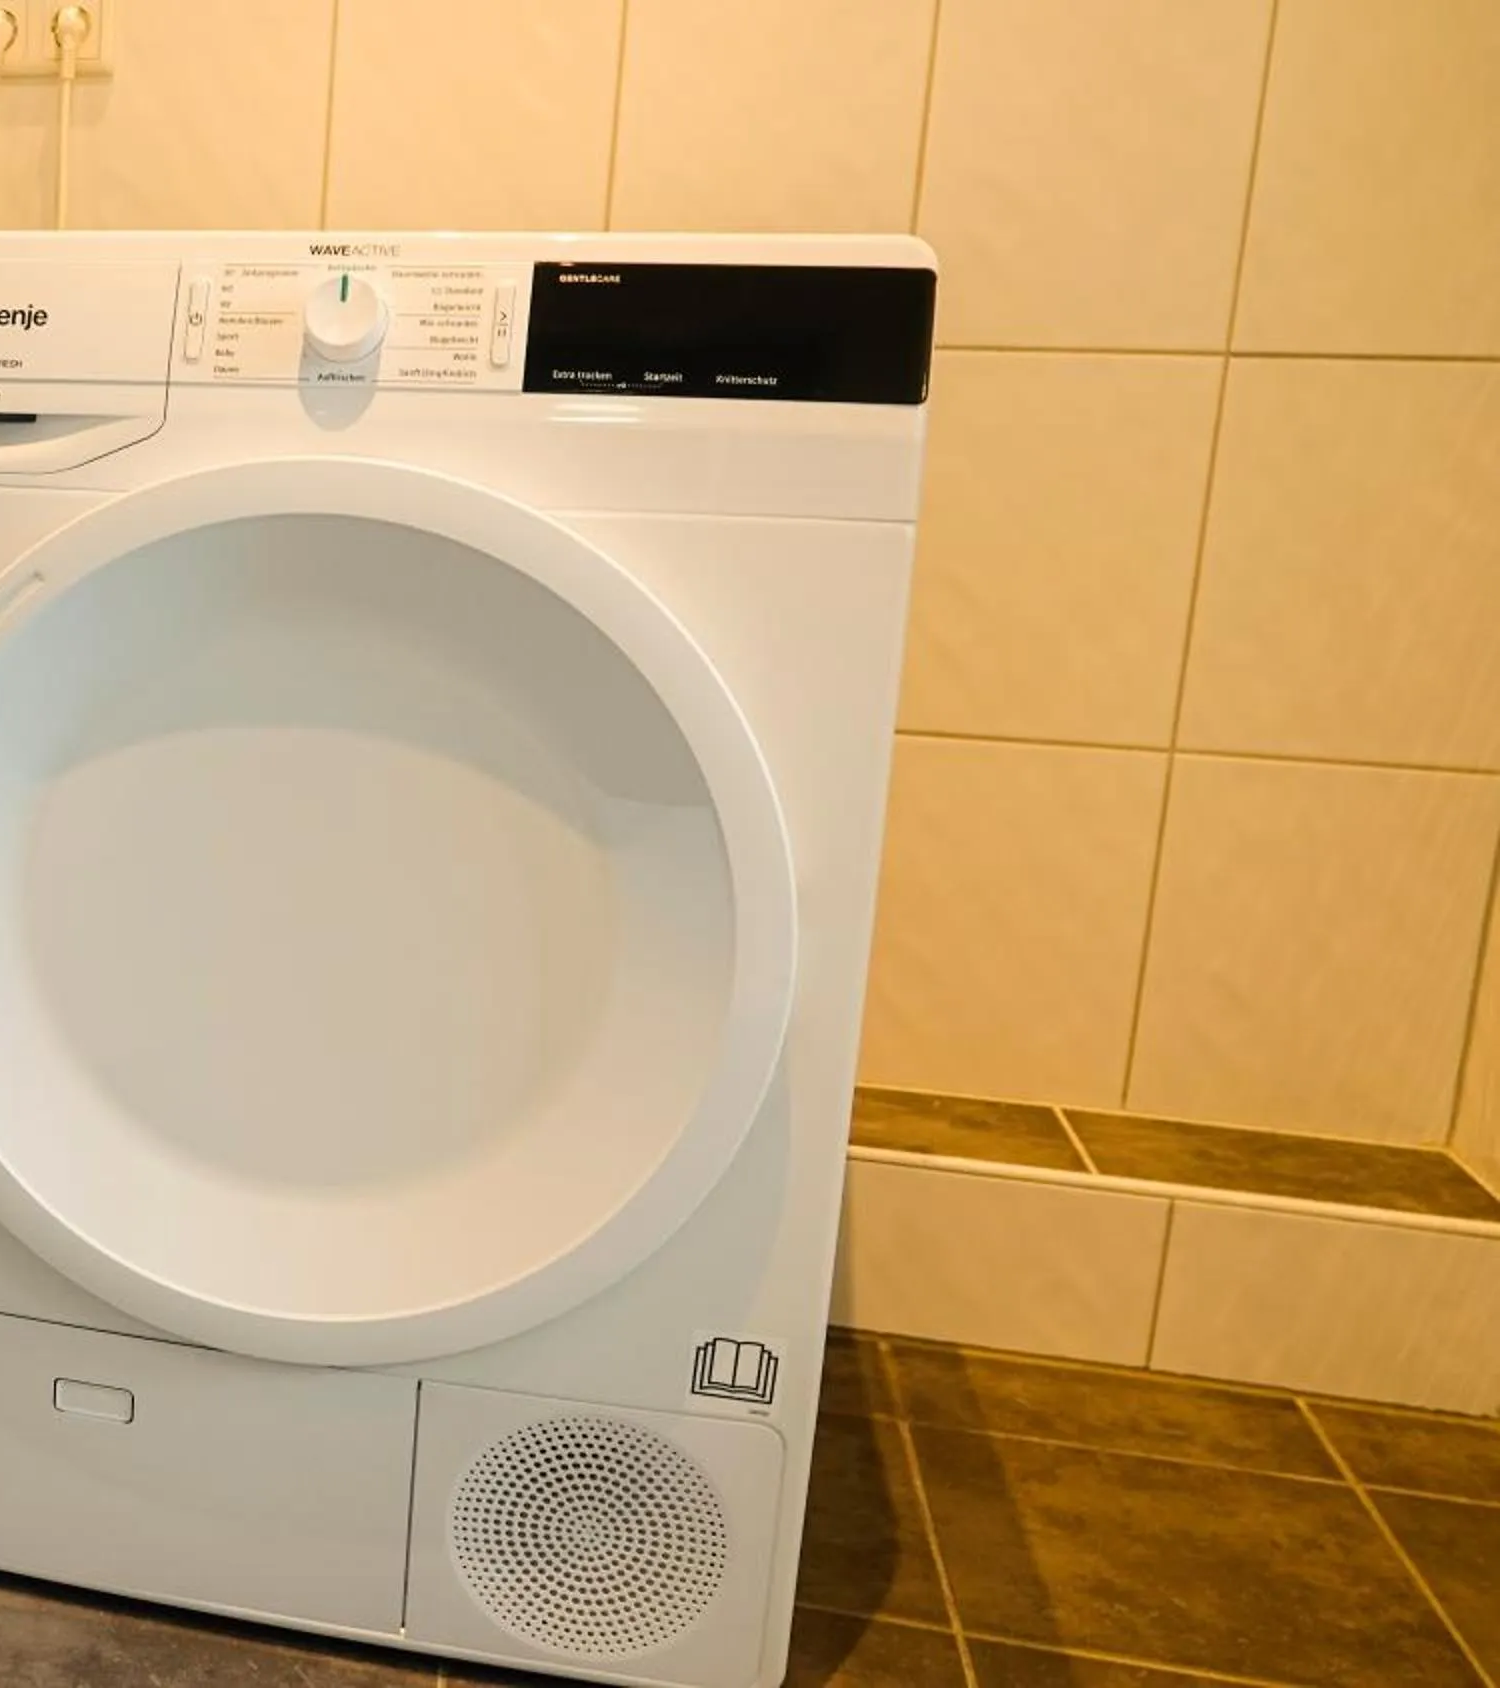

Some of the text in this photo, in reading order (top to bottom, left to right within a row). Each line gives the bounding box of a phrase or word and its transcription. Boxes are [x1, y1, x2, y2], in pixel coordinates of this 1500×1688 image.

[308, 245, 402, 257] WAVEACTIVE
[558, 273, 621, 284] GENTLECARE
[552, 369, 576, 380] Extra
[643, 371, 683, 383] Startzeit
